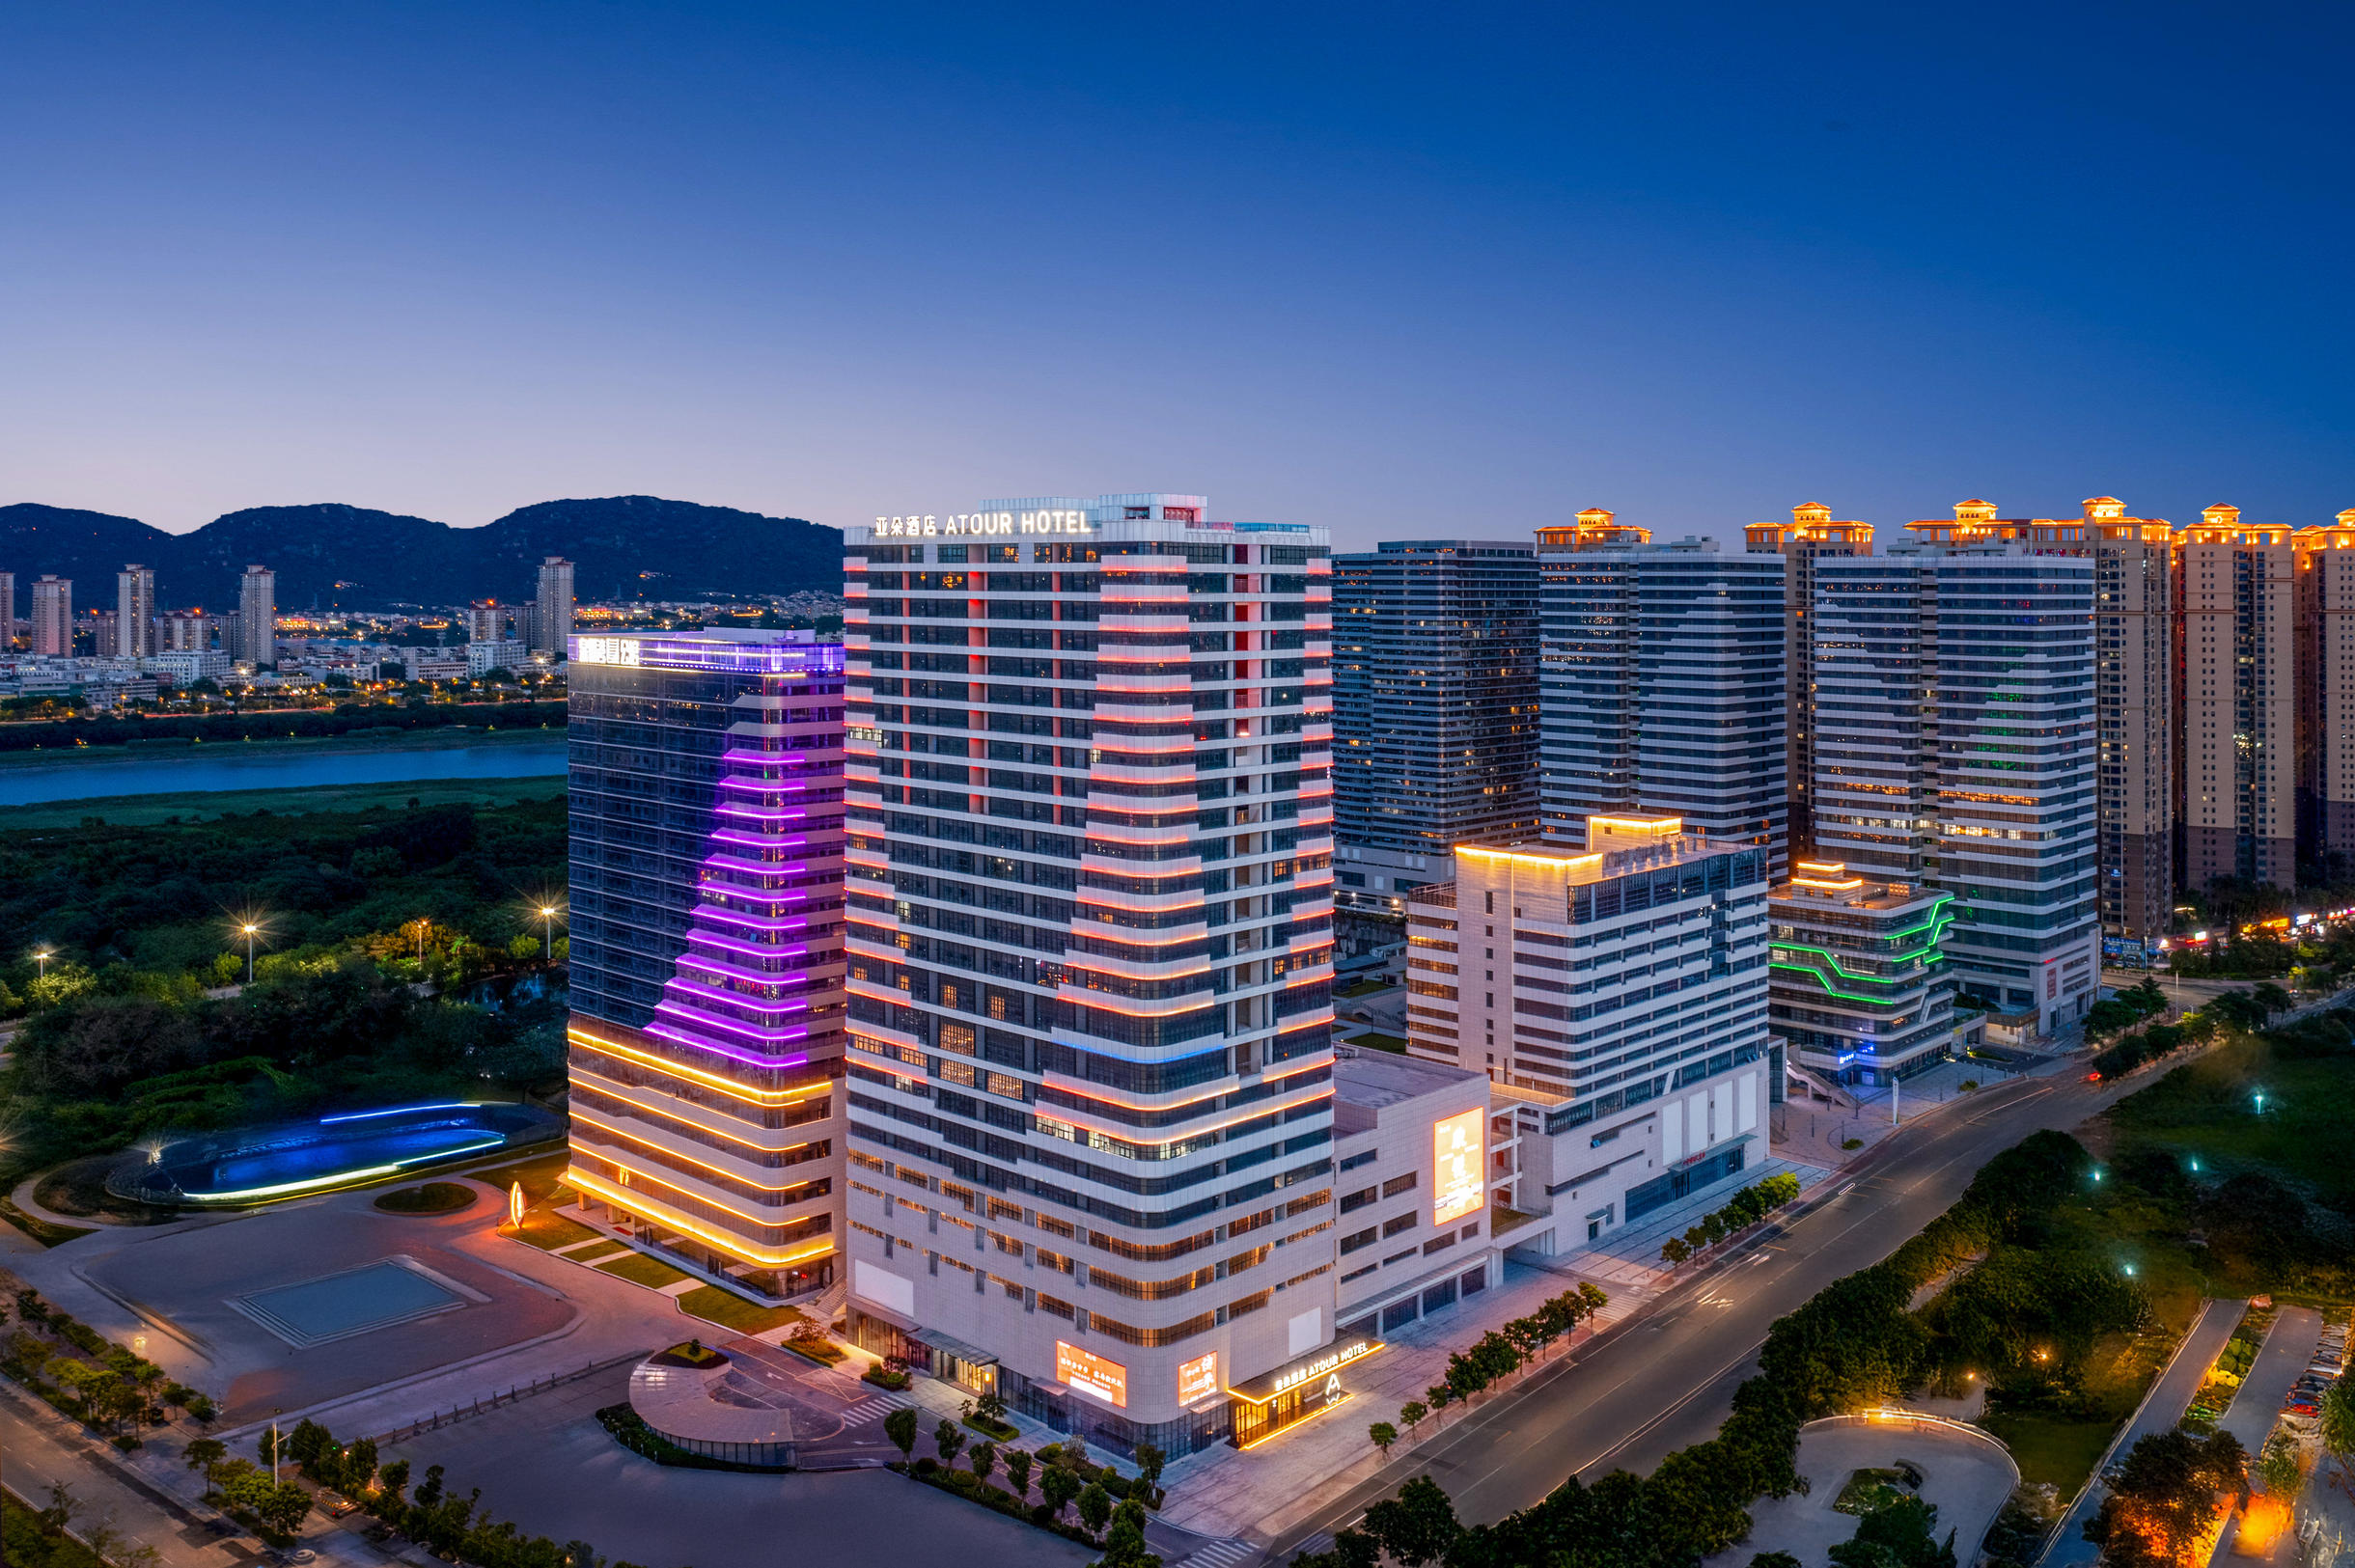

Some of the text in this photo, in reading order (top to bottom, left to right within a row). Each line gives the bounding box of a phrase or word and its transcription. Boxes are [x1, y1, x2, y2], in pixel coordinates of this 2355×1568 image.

[875, 514, 936, 536] 亚朵酒店
[945, 510, 1092, 535] ATOUR HOTEL
[1309, 1342, 1368, 1376] ATOUR HOTEL
